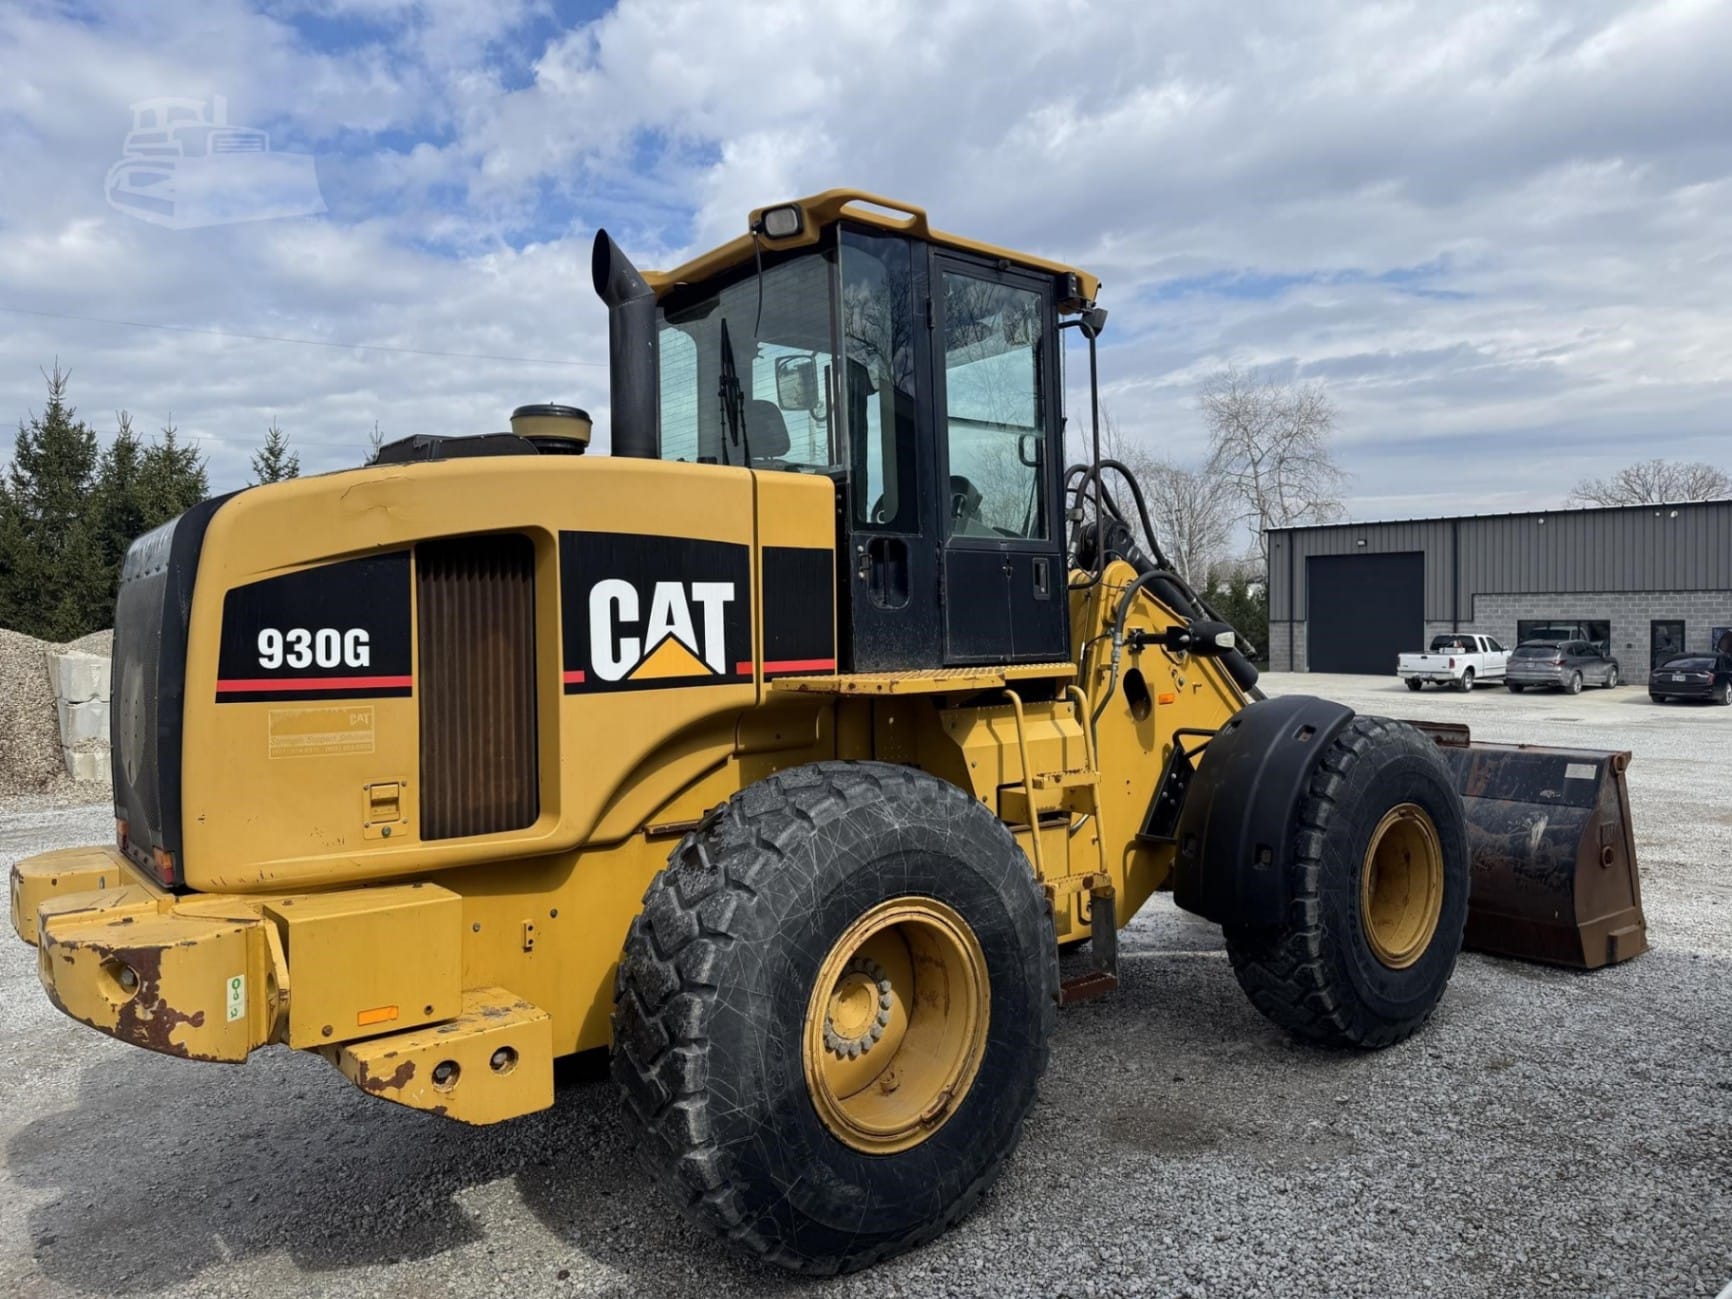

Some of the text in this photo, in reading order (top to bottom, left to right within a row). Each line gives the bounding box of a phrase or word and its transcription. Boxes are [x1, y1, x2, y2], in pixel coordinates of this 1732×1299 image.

[257, 627, 370, 669] 930G
[589, 578, 735, 682] CAT
[349, 712, 370, 726] CAT
